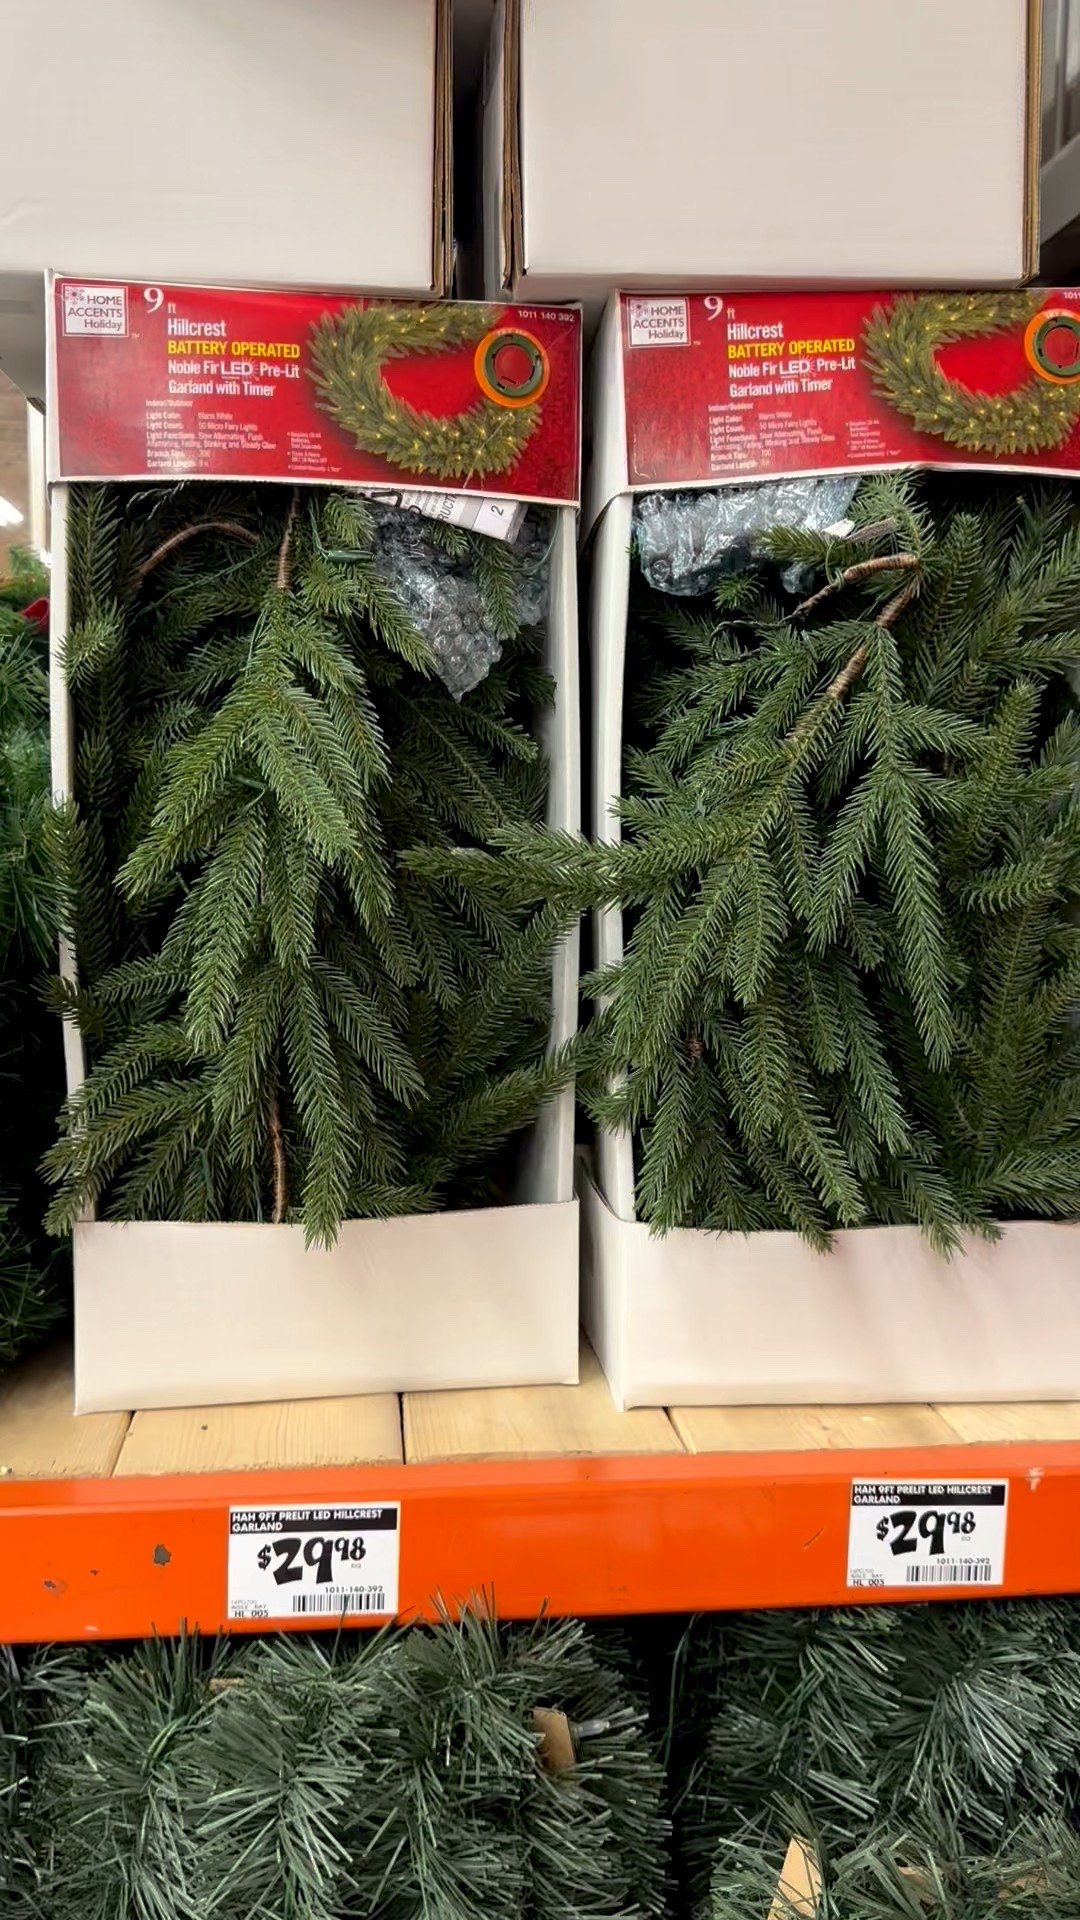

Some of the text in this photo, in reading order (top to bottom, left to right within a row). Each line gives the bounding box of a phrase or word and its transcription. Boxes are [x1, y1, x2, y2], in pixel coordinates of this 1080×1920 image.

[86, 295, 122, 306] HOME
[143, 287, 176, 314] 9 ft
[68, 307, 122, 318] ACCENTS
[651, 305, 684, 316] HOME
[703, 296, 736, 321] 9 ft
[518, 310, 537, 318] 1011
[540, 312, 556, 320] 140
[84, 319, 122, 332] Holiday
[167, 318, 227, 337] Hillcrest
[633, 318, 684, 329] ACCENTS
[648, 329, 684, 341] Holiday
[727, 322, 784, 340] Hillcrest
[167, 340, 300, 358] BATTERY OPERATED
[728, 339, 855, 359] BATTERY OPERATED
[168, 360, 300, 378] Noble Fir LED Pre-Lit
[729, 357, 856, 378] Noble Fir LED Pre-Lit
[168, 380, 276, 397] Garland with Timer
[730, 378, 833, 398] Garland with Timer
[490, 505, 505, 517] 2
[855, 1485, 992, 1494] HAH 9FT PRELIT LED HILLCREST
[854, 1495, 900, 1504] GARLAND
[232, 1509, 383, 1522] HAH 9FT PRELIT LED HILLCREST
[232, 1522, 283, 1532] GARLAND
[937, 1557, 990, 1565] 1011-140-392
[325, 1586, 384, 1594] 1011-140-392
